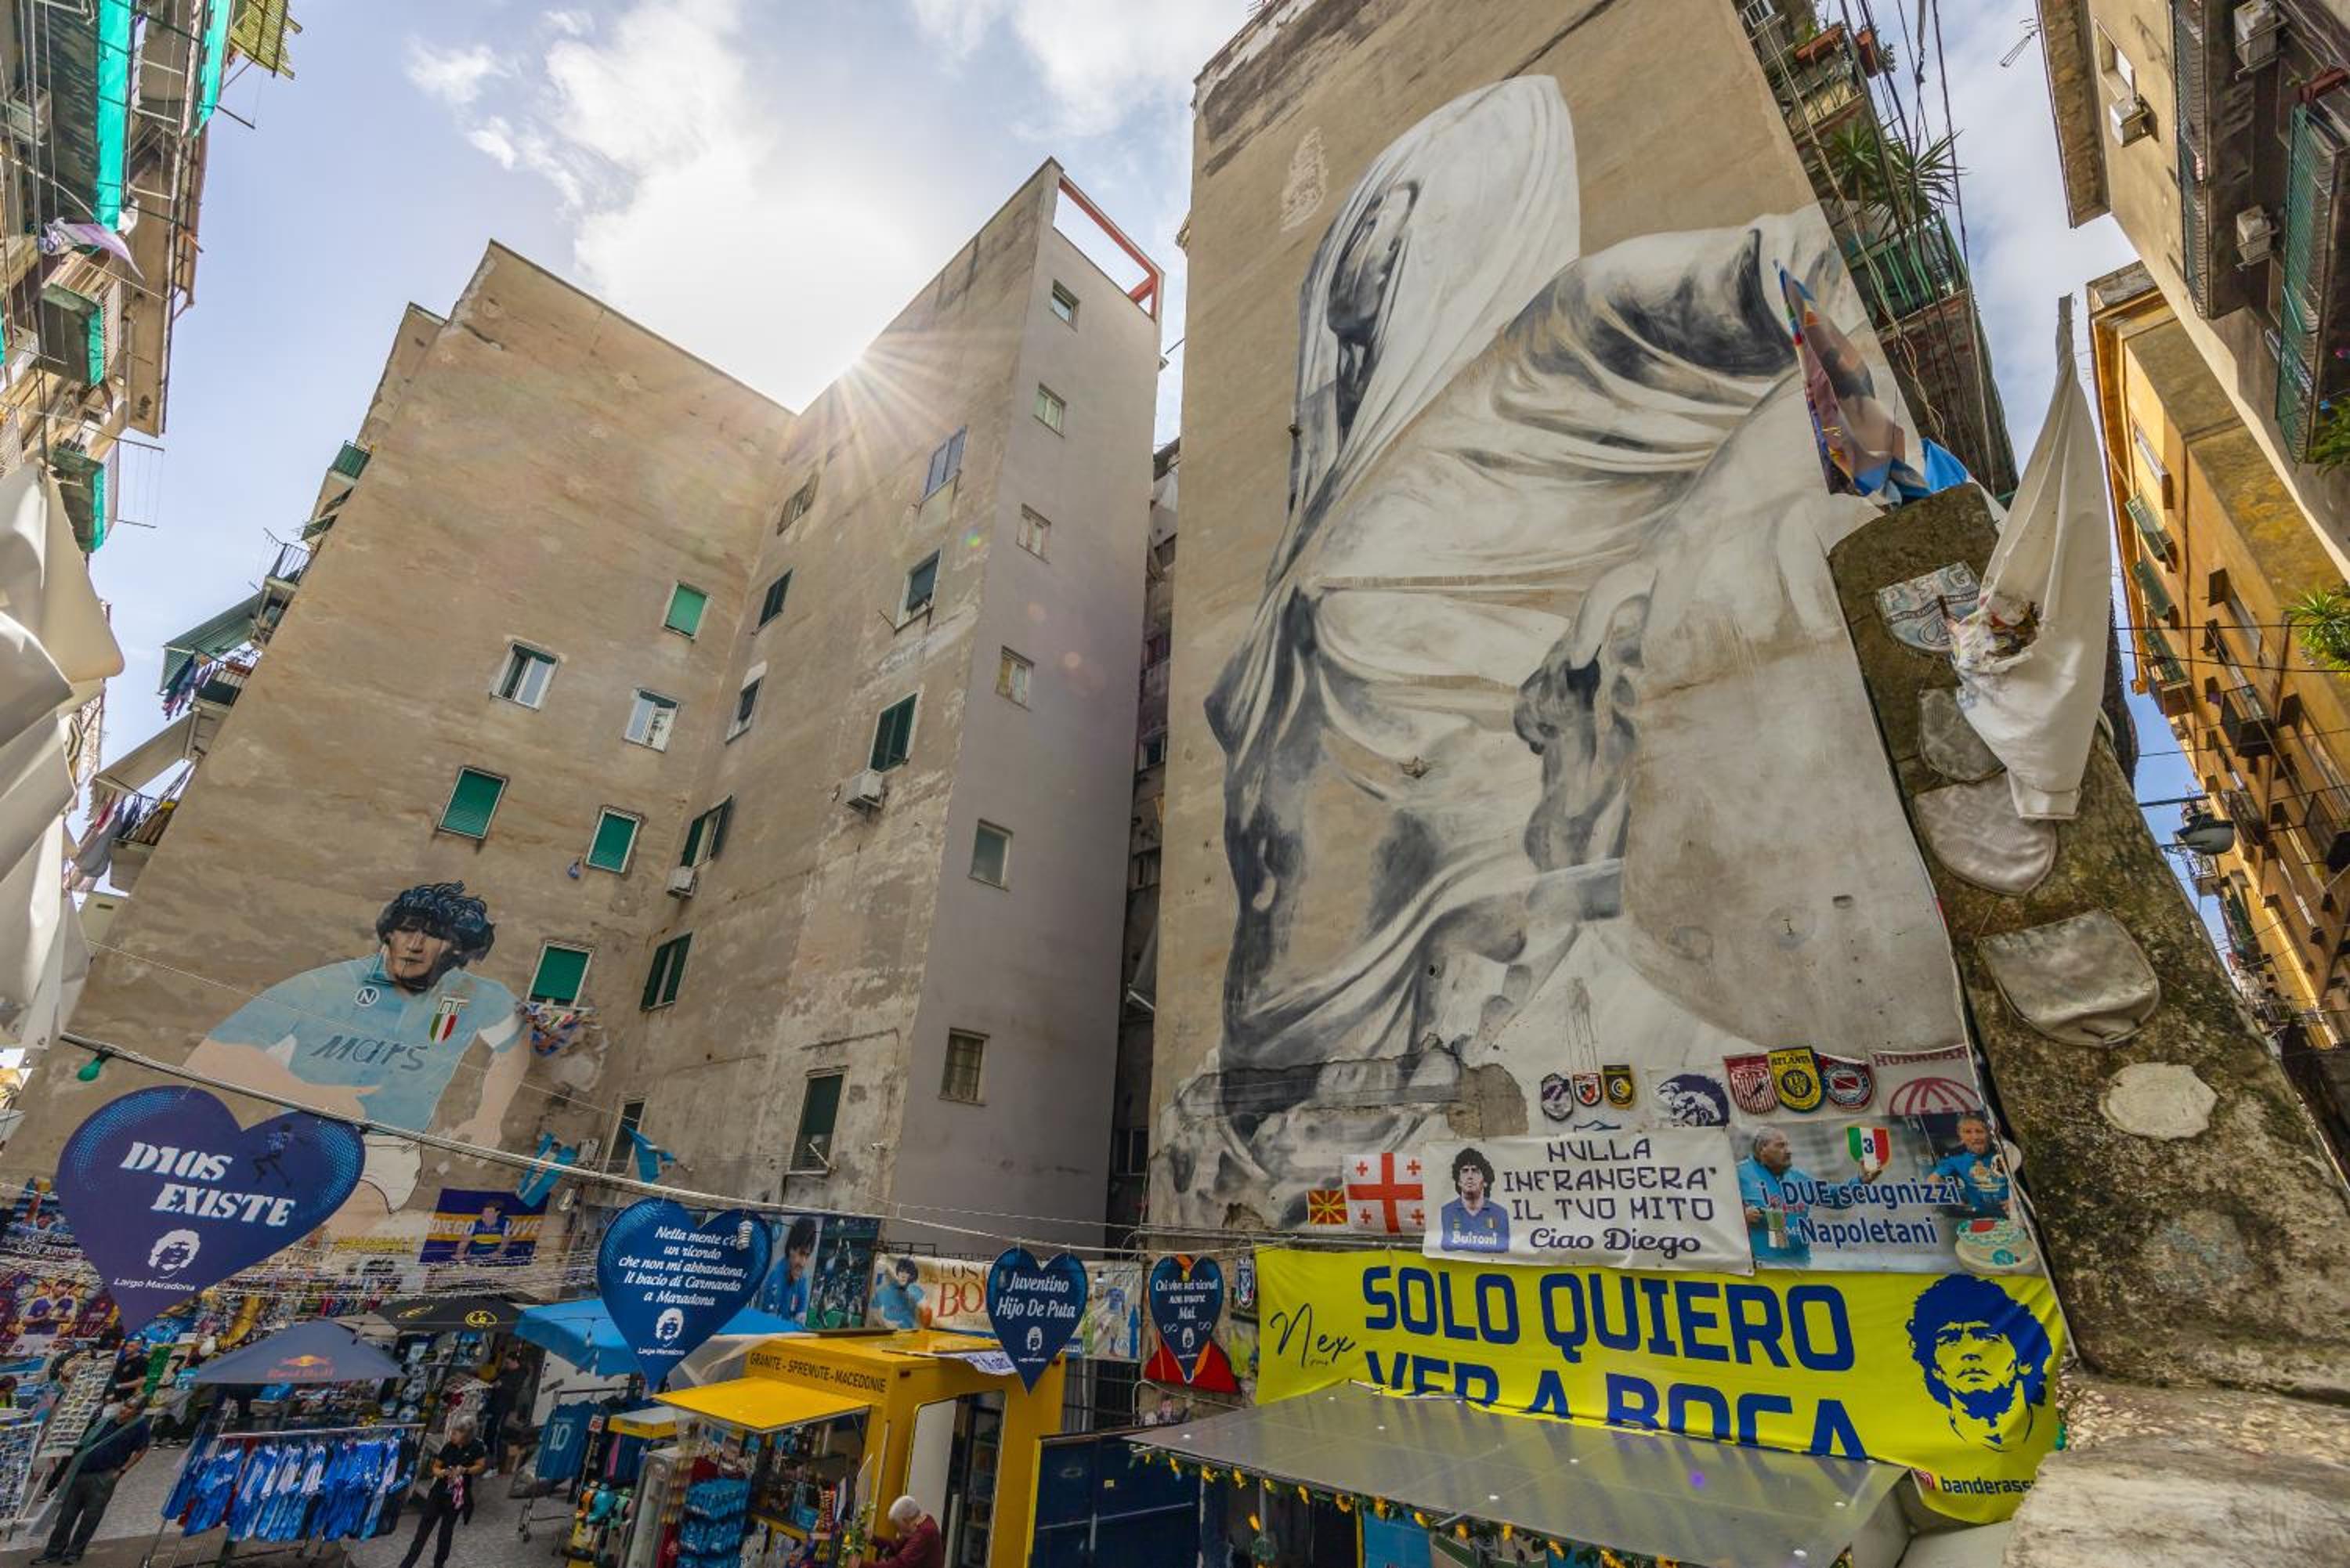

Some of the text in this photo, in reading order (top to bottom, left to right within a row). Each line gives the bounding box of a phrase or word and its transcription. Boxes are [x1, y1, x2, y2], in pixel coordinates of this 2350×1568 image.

[1546, 1138, 1651, 1163] NULLA
[1864, 1138, 1875, 1154] 3
[150, 1183, 297, 1227] EXISTE
[1760, 1176, 1959, 1211] i DUE scugnizzi
[1513, 1198, 1715, 1222] IL TUO MITO
[655, 1226, 686, 1241] Nella
[687, 1230, 721, 1245] mente
[1530, 1227, 1701, 1259] Ciao Diego
[1798, 1216, 1938, 1249] Napoletani
[663, 1245, 721, 1260] un ricordo
[618, 1255, 748, 1280] che non mi abbandona,
[114, 1277, 197, 1292] Largo Maradona
[637, 1272, 668, 1287] bacio
[668, 1274, 682, 1288] di
[685, 1276, 742, 1292] Carmando
[1007, 1272, 1070, 1293] Juventino
[643, 1291, 716, 1306] a Maradona
[996, 1295, 1076, 1320] Hijo De Puta
[1362, 1265, 1856, 1372] SOLO QUIERO
[750, 1353, 783, 1371] GRANITE
[788, 1359, 830, 1381] SPREMUTE
[835, 1370, 887, 1393] MACEDONIE
[1522, 1370, 1572, 1420] A
[549, 1424, 570, 1451] 10
